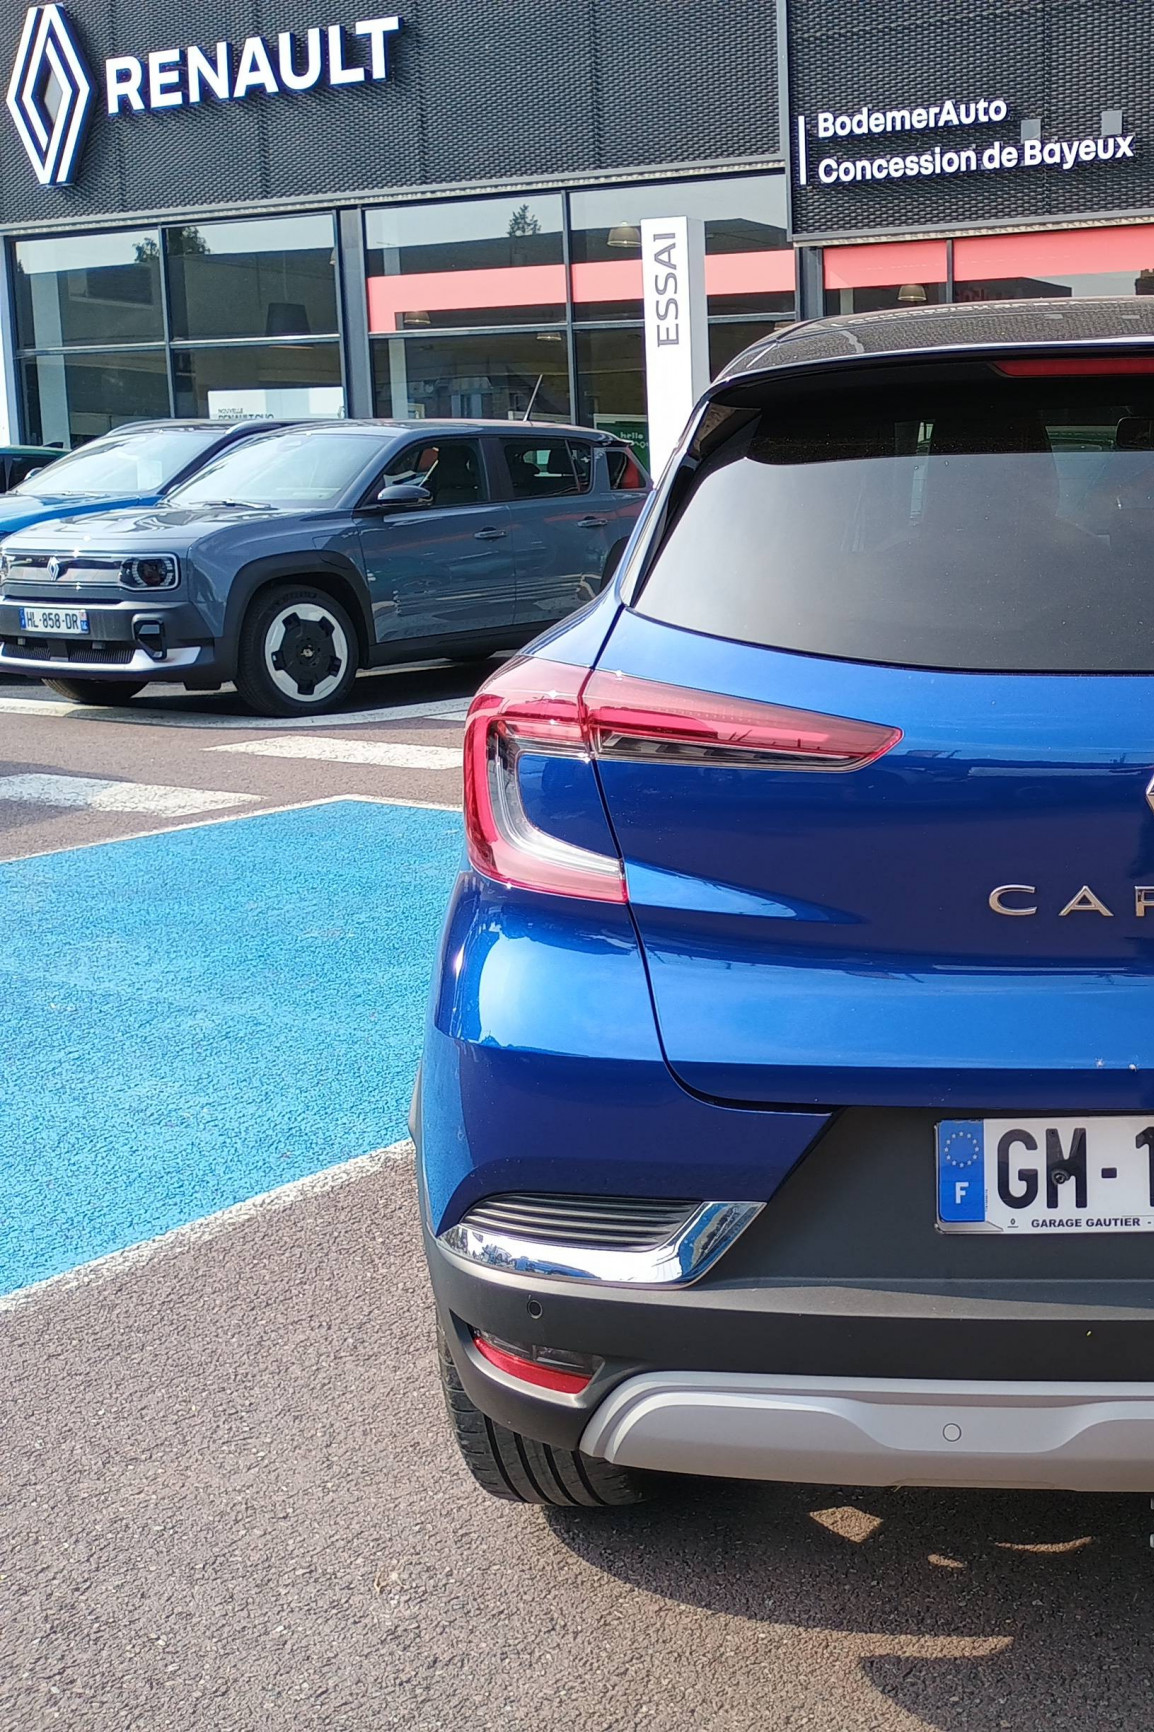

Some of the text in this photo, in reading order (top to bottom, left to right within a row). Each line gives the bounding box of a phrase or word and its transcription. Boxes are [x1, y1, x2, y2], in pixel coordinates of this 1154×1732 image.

[105, 16, 400, 115] RENAULT
[818, 98, 1008, 138] BodemerAuto
[818, 135, 1135, 184] Concession de Bayeux
[653, 232, 679, 348] ESSAI
[26, 611, 79, 630] HL-858-DR
[955, 1182, 969, 1204] F
[1031, 1218, 1082, 1228] GARAGE
[1085, 1217, 1140, 1227] GAUTIER
